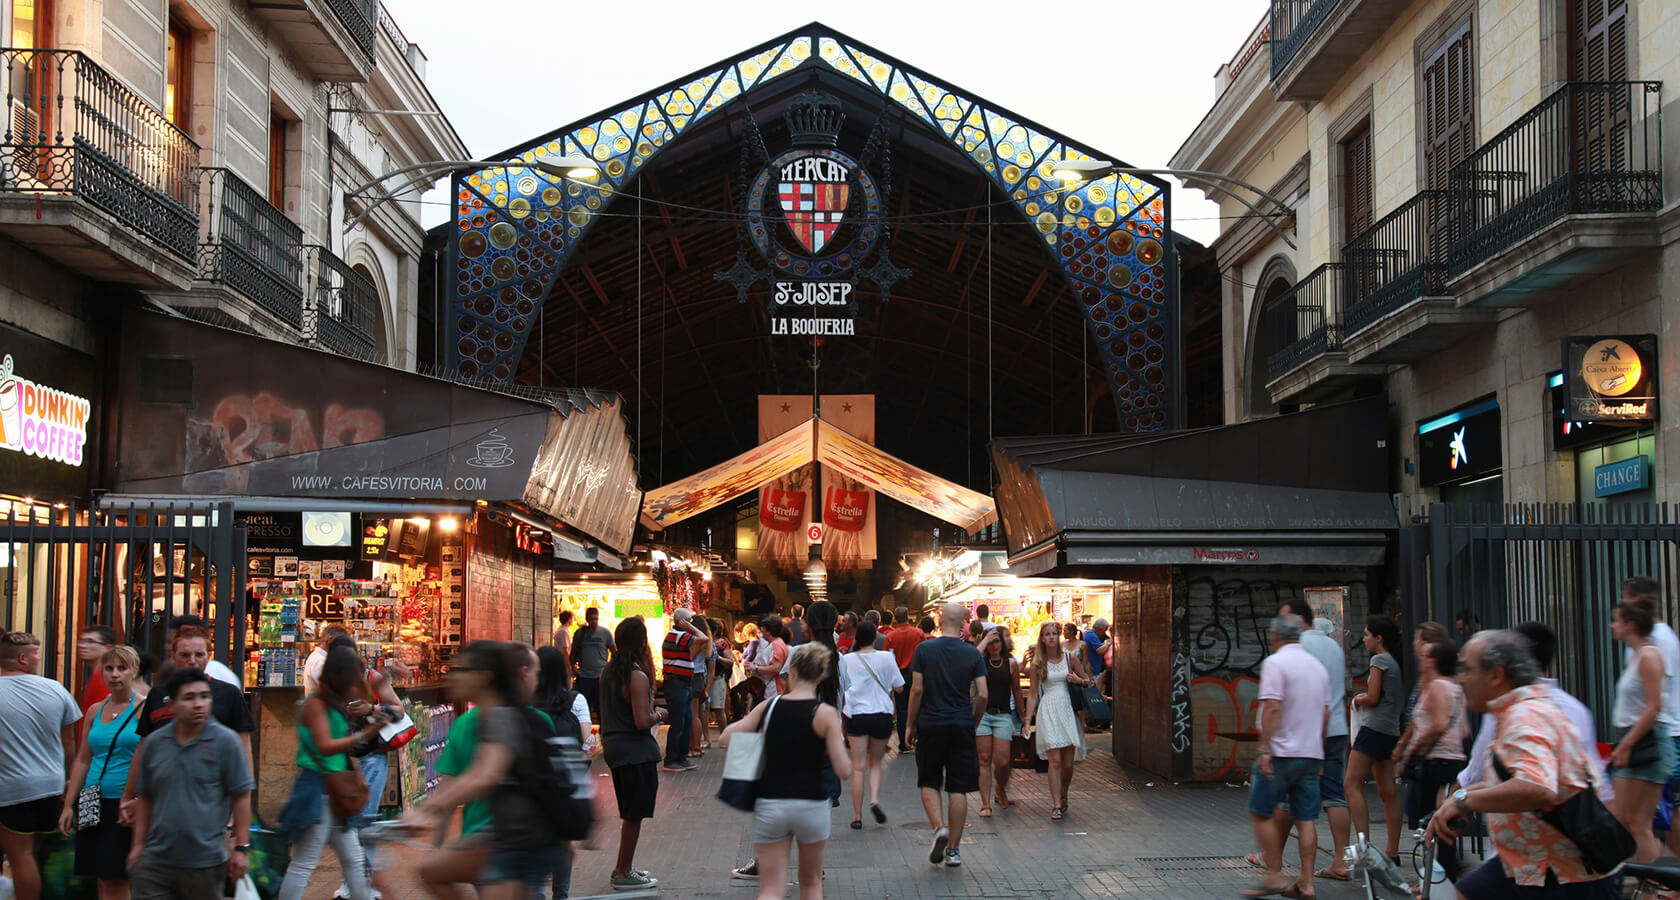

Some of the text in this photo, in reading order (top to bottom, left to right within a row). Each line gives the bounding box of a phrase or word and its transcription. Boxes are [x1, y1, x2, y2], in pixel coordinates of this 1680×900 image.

[781, 157, 849, 182] MERCAT
[792, 282, 852, 305] JOSEP
[771, 317, 855, 336] LA BOQUERIA
[24, 384, 88, 430] DUNKIN'
[1598, 402, 1647, 415] ServiRed
[23, 418, 82, 462] COFFEE
[1596, 464, 1640, 490] CHANGE
[767, 502, 799, 517] Estrella
[830, 502, 862, 517] Estrella
[811, 528, 818, 539] 6
